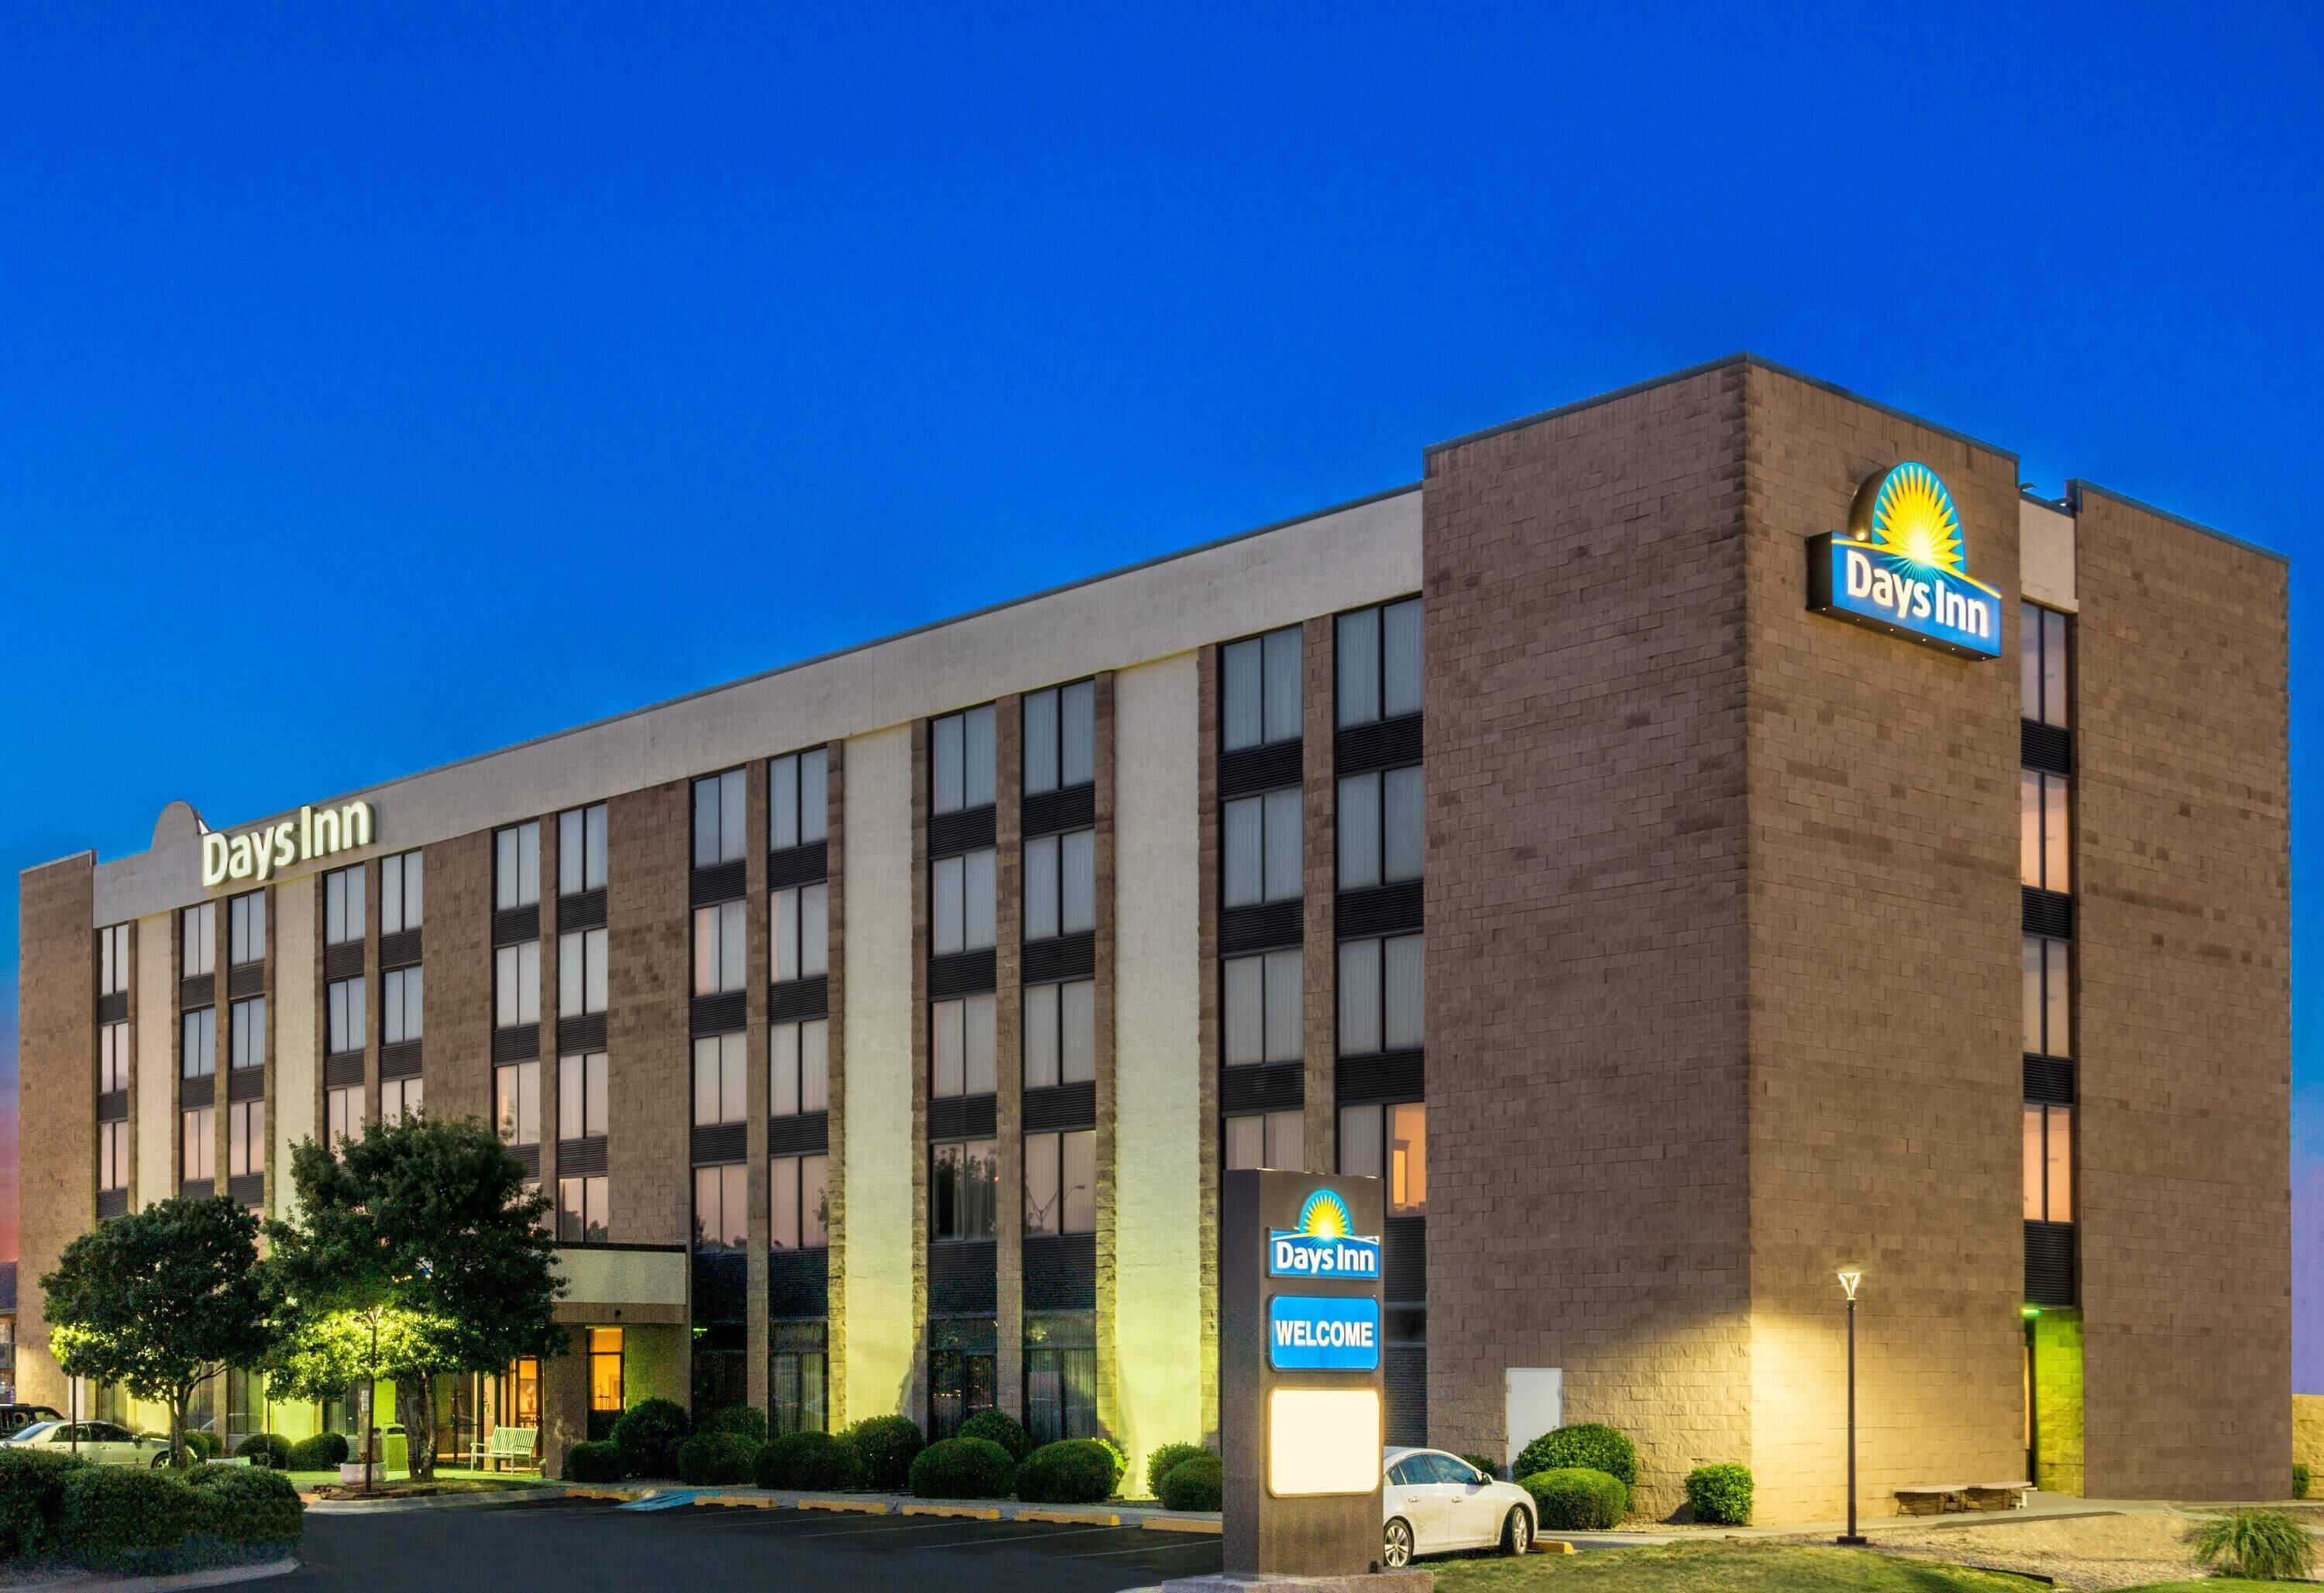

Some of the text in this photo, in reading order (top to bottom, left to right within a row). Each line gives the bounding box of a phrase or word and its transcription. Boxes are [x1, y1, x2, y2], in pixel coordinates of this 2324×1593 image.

[1846, 549, 1989, 637] Days Inn
[202, 801, 371, 887] Days Inn
[1276, 1241, 1375, 1274] Days Inn
[1275, 1320, 1373, 1348] WELCOME
